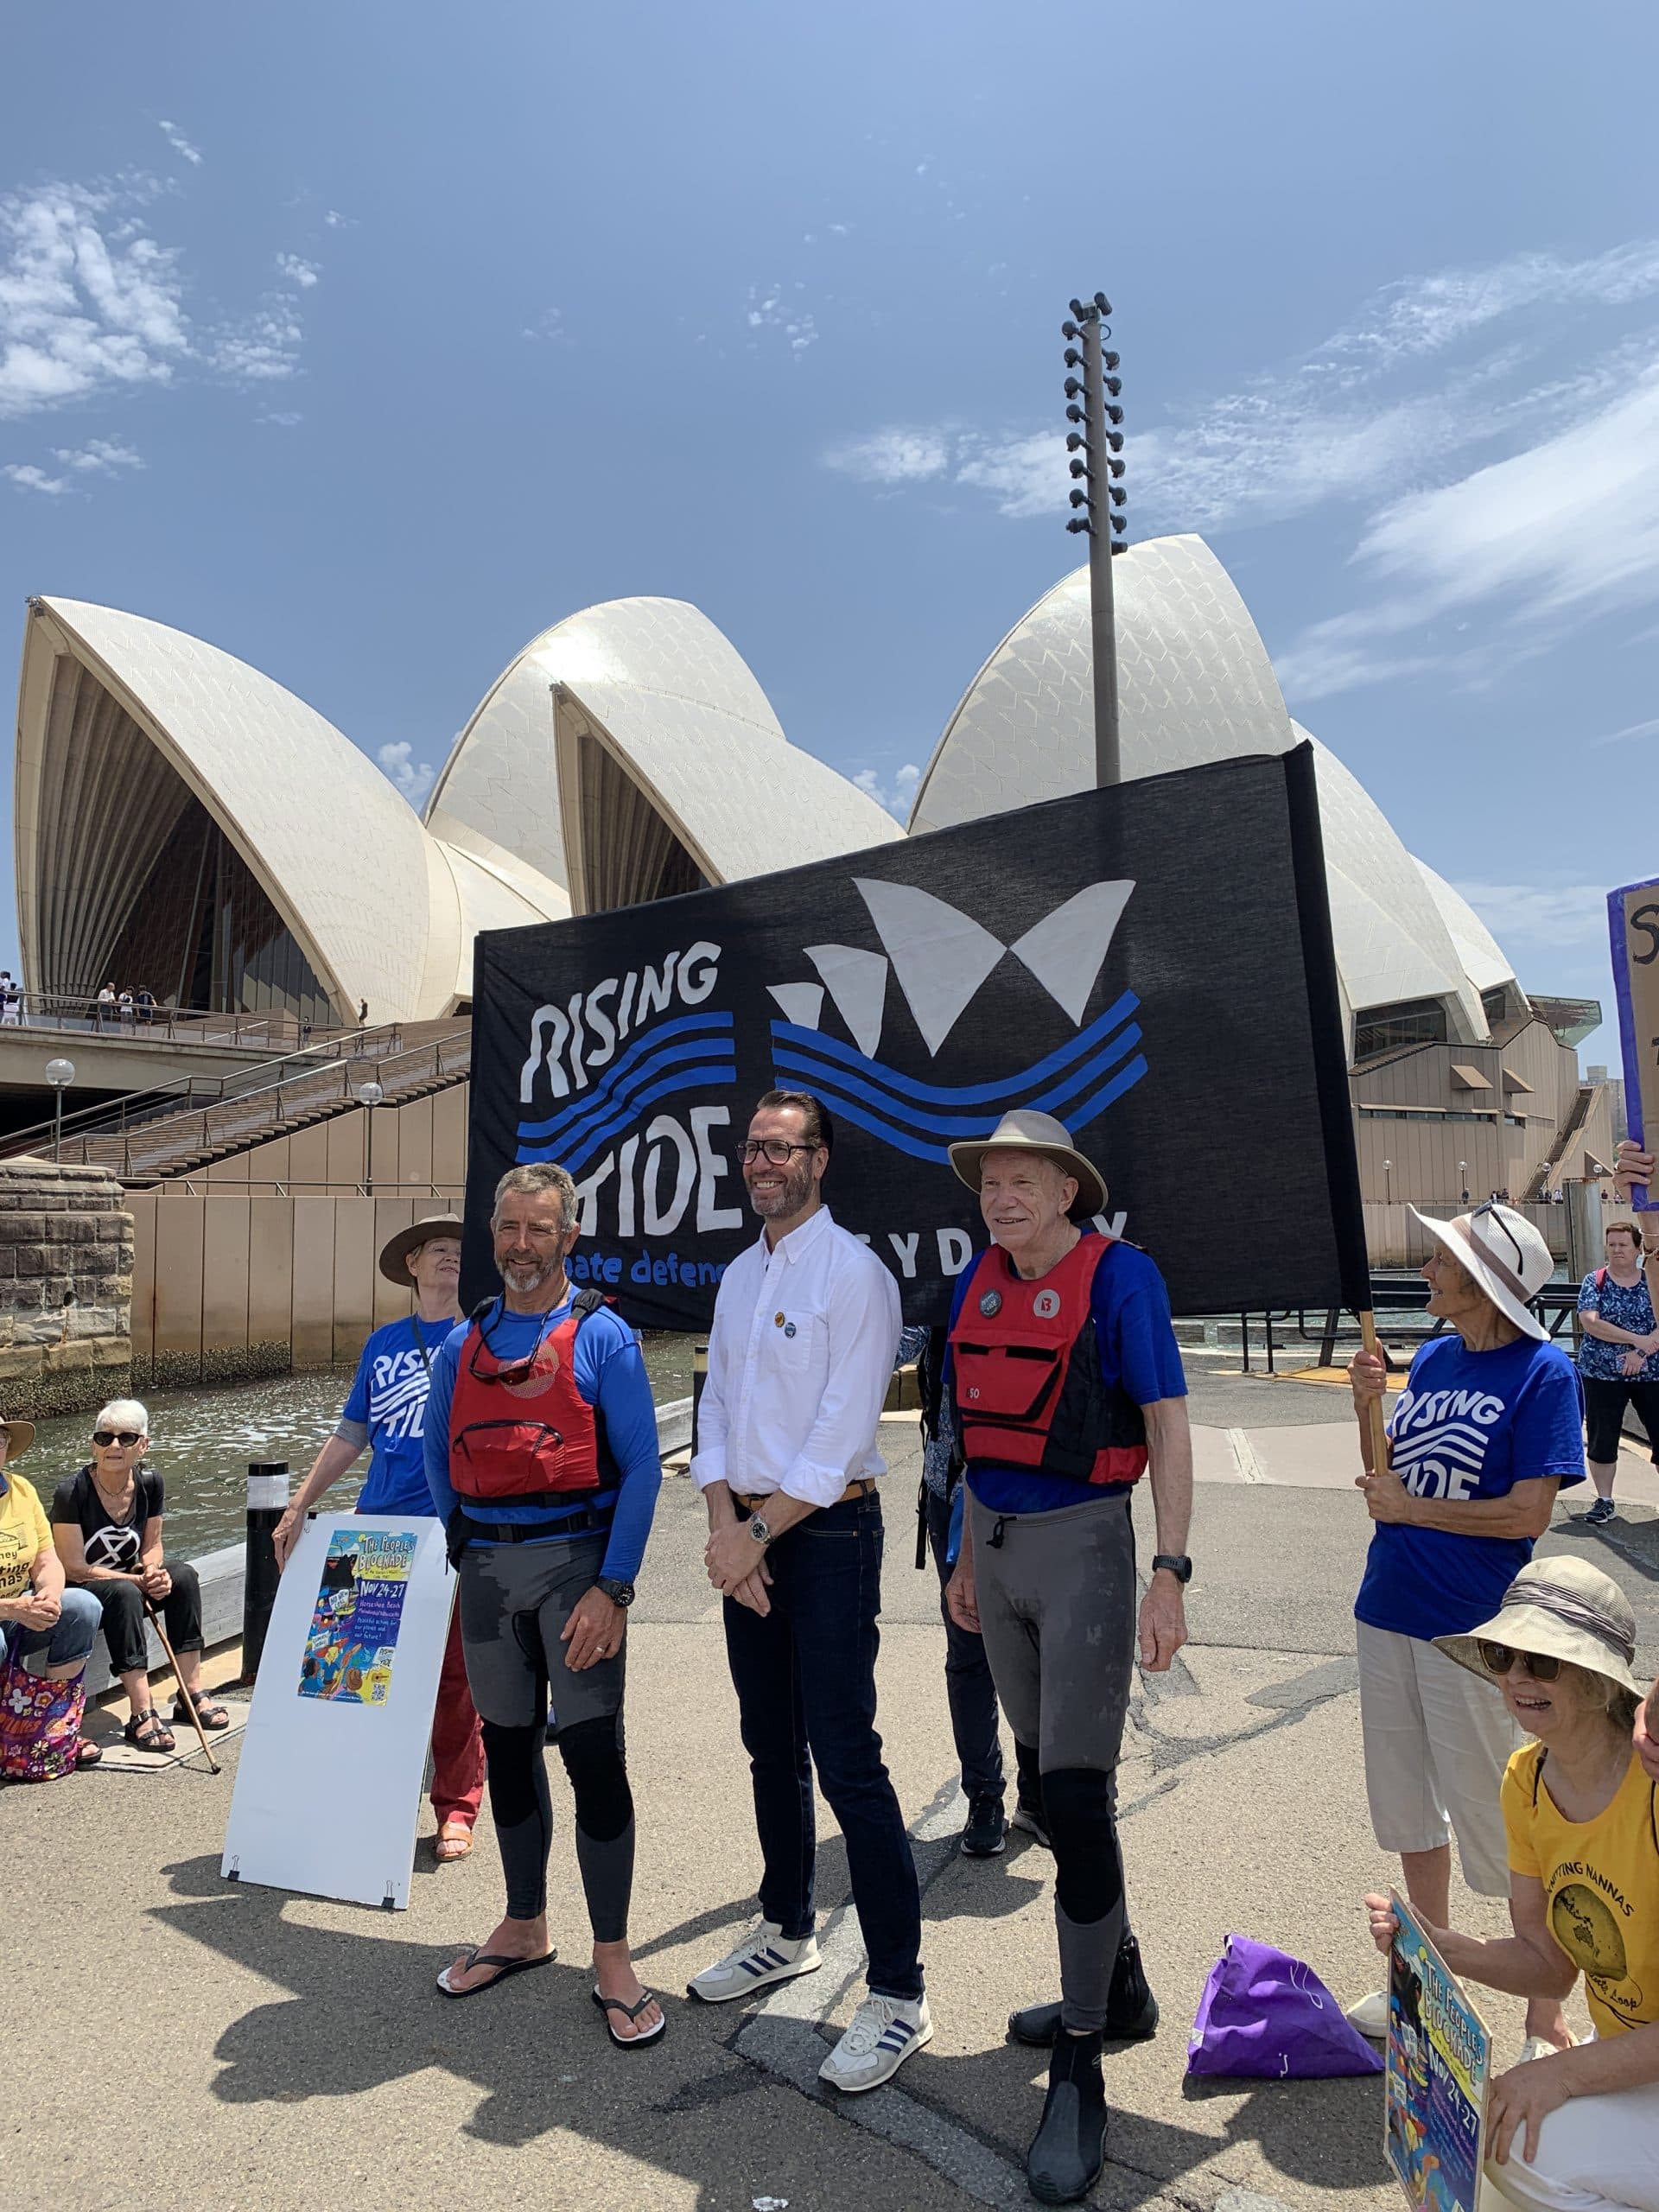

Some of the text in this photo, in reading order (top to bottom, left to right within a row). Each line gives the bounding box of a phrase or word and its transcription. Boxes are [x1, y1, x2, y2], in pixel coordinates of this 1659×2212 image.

[520, 941, 721, 1103] RISING
[1392, 1389, 1505, 1437] RISING
[359, 1554, 407, 1571] BLOCKADE
[364, 1535, 378, 1553] THE
[376, 1583, 404, 1598] 24-27
[1586, 1863, 1634, 1916] NANNAS
[1426, 1960, 1443, 2003] THE
[1425, 1989, 1477, 2086] BLOCKADE
[1448, 2080, 1477, 2139] 24-27
